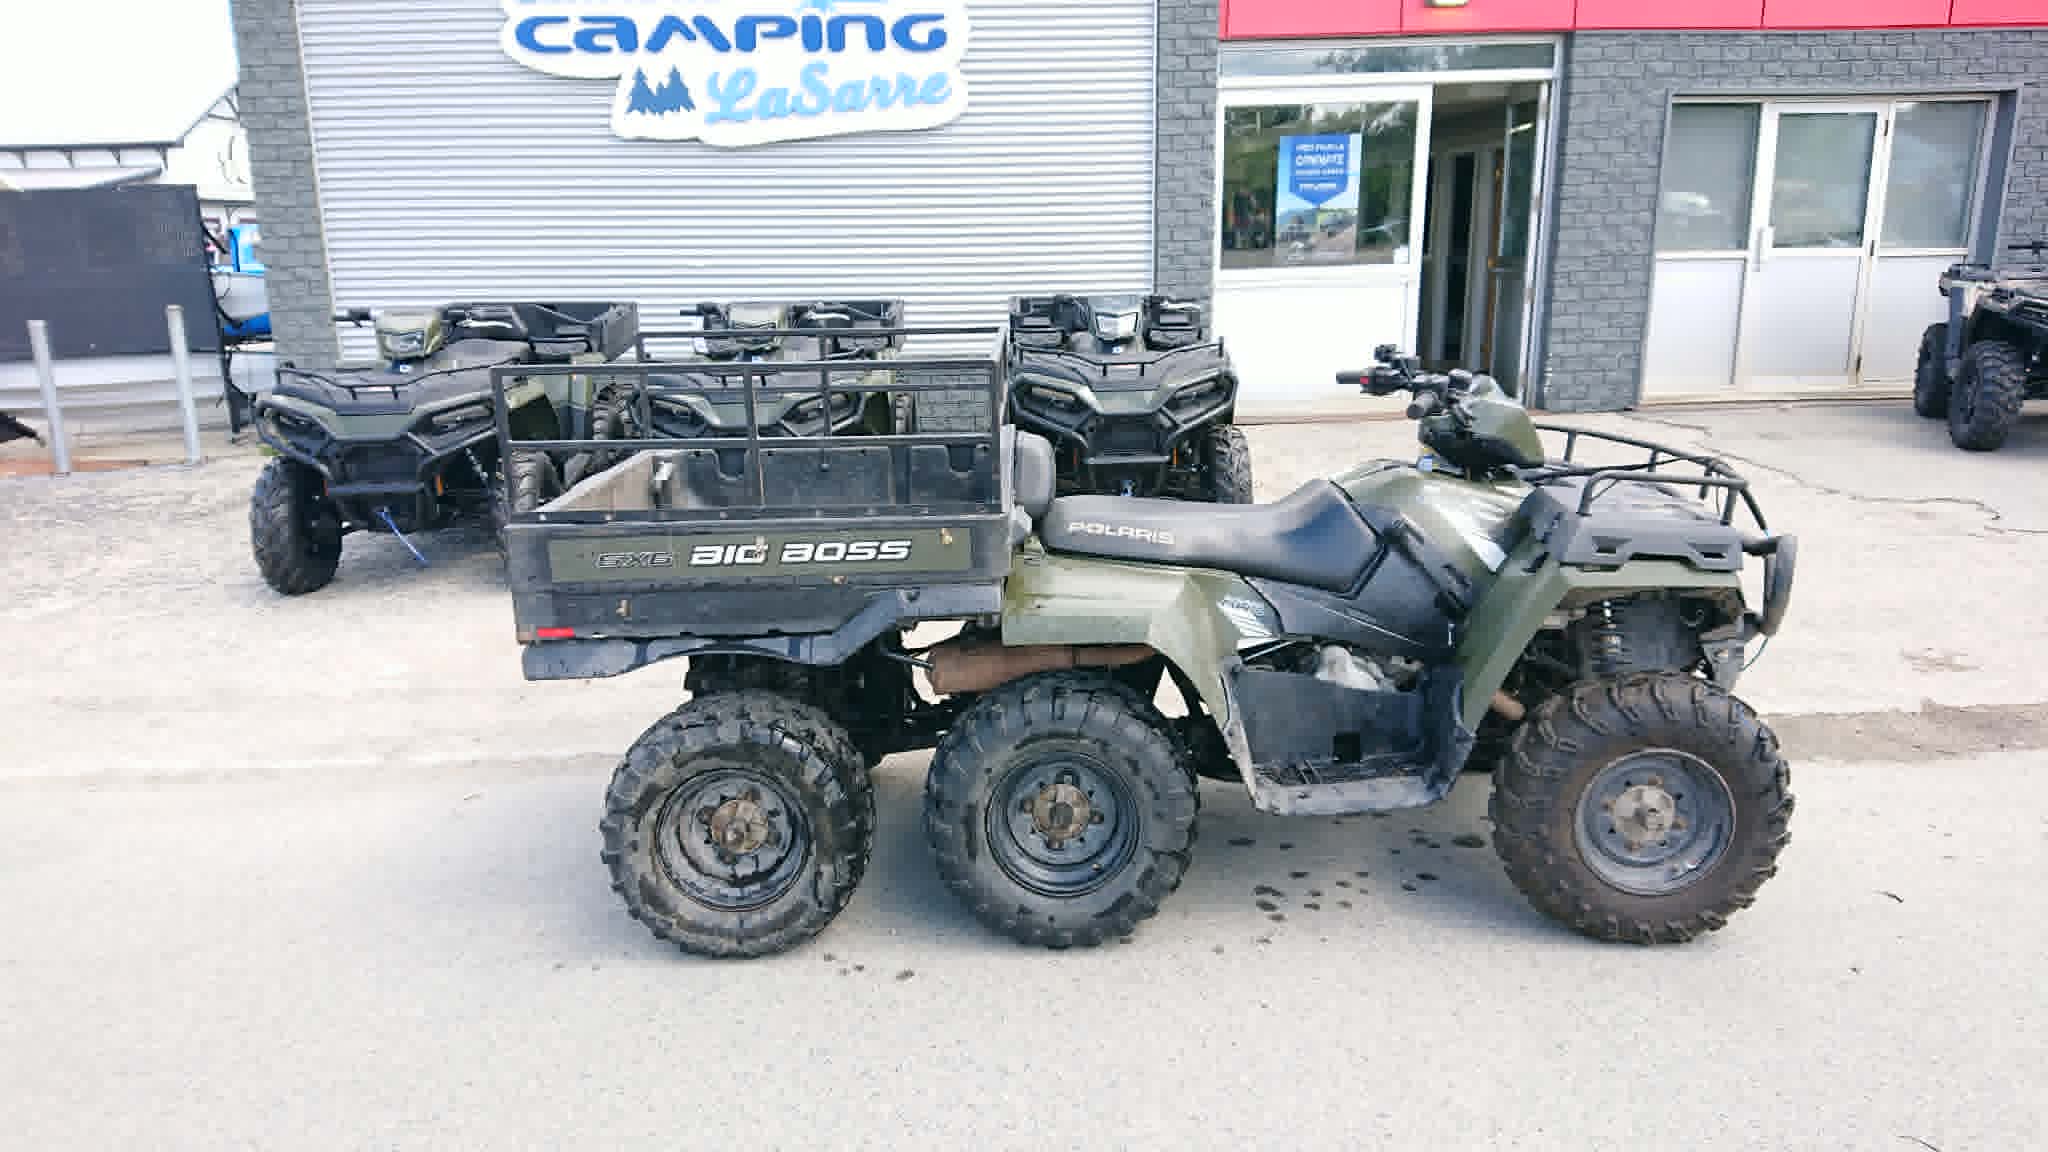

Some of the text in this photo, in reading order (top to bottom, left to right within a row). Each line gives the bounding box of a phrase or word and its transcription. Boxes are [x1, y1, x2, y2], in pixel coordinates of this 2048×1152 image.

[703, 60, 953, 125] LaSarre
[1065, 520, 1176, 545] POLARIS
[689, 543, 768, 567] BIG
[780, 539, 912, 565] BOSS
